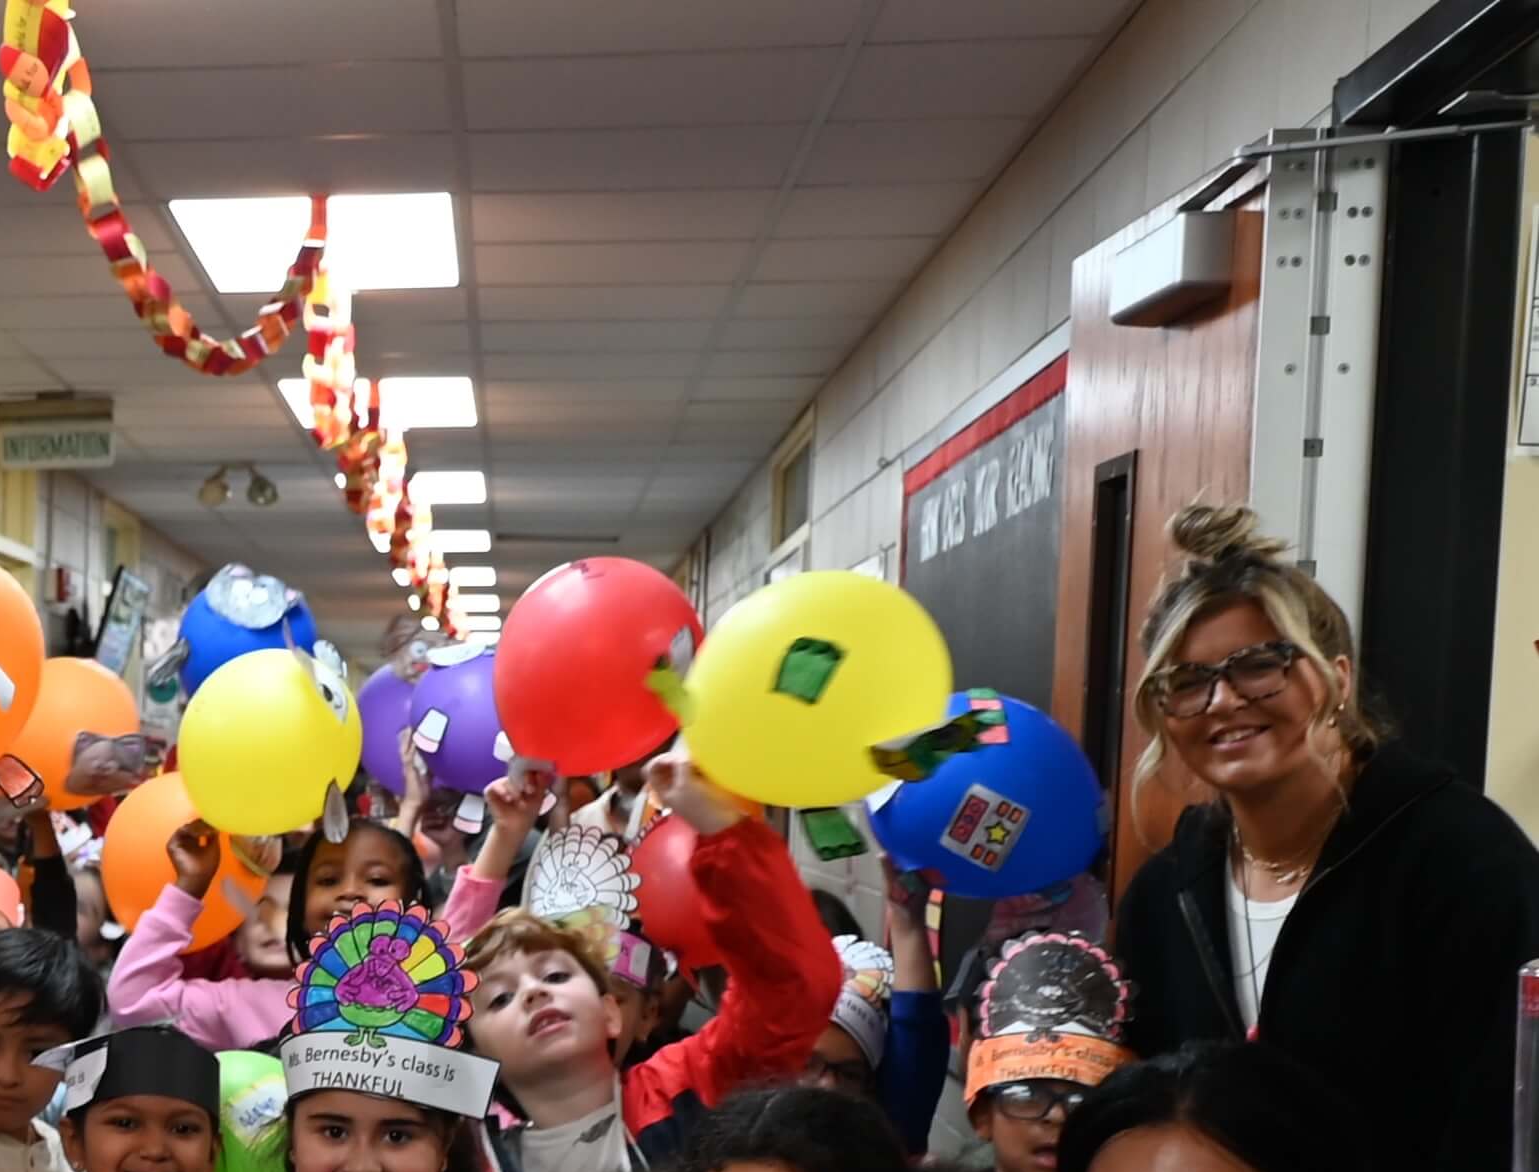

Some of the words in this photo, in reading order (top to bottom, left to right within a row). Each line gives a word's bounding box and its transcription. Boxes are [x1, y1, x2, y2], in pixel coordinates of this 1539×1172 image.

[2, 431, 111, 463] INFORMATION
[304, 1046, 397, 1069] Bernesby's
[401, 1055, 441, 1078] class
[444, 1064, 456, 1082] is
[311, 1071, 405, 1098] THANKFUL
